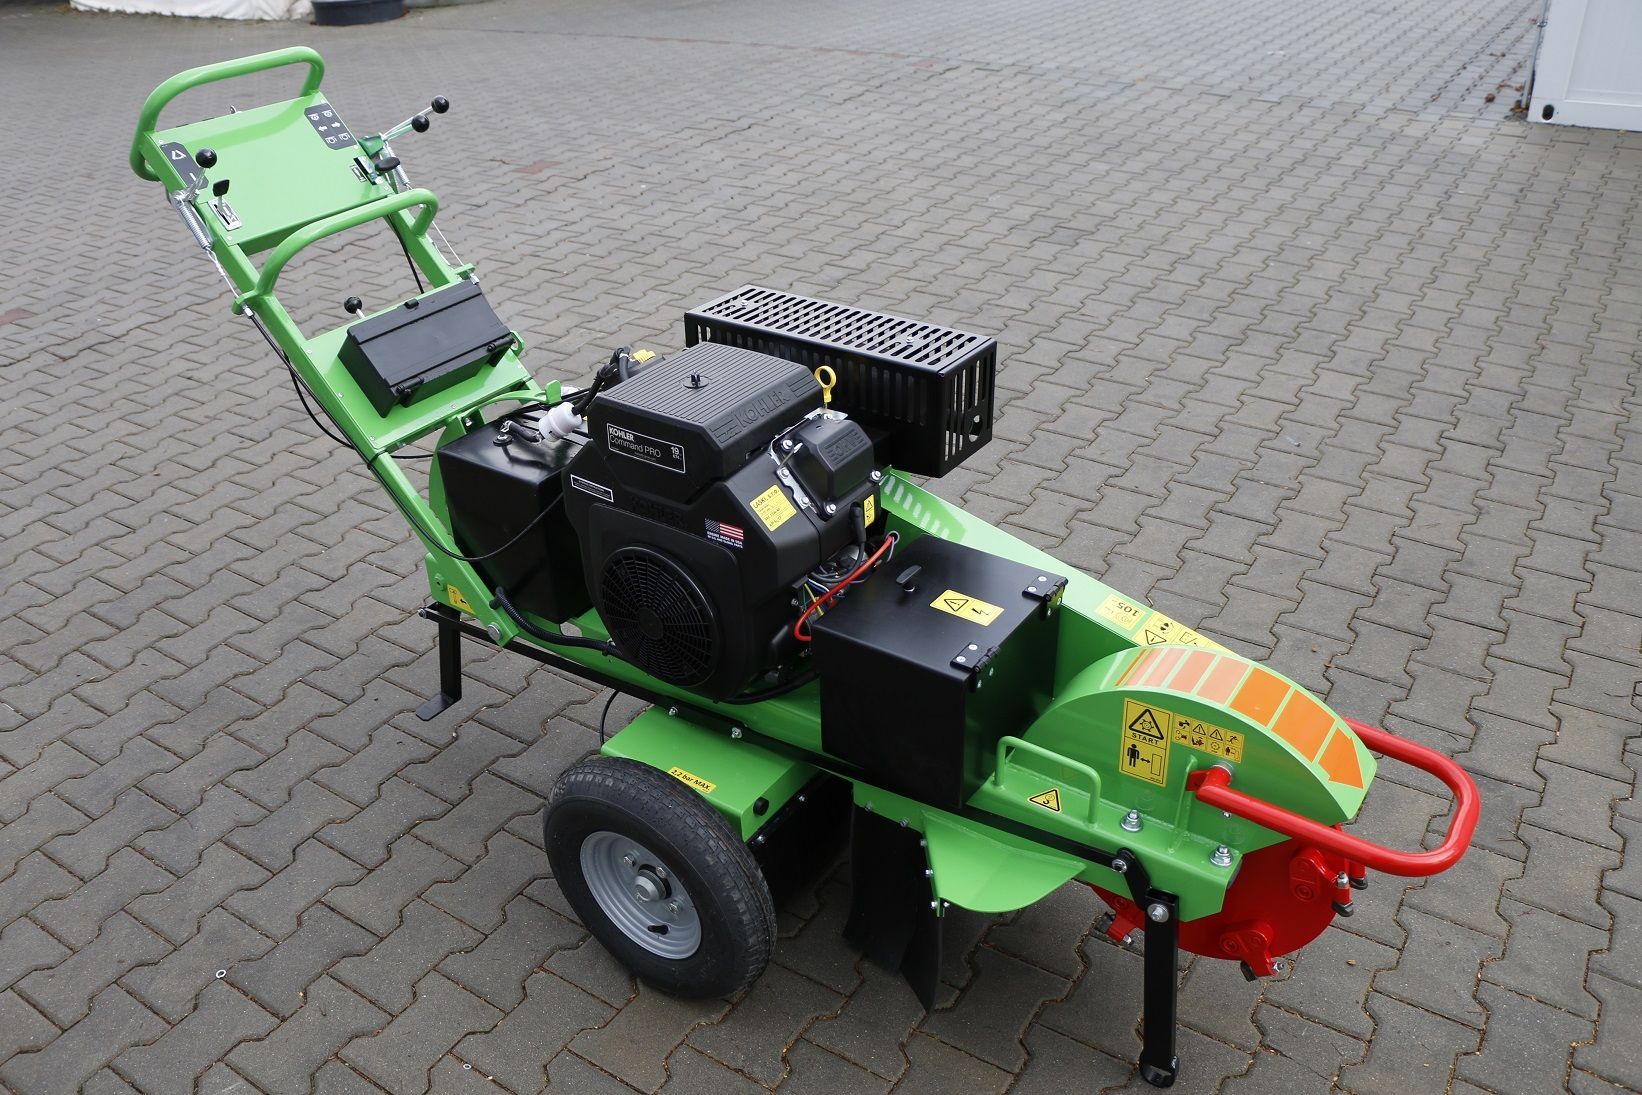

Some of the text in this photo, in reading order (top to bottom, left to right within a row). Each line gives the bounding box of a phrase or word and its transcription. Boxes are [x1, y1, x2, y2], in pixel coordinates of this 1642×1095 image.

[732, 391, 790, 428] KOHLER
[609, 426, 635, 442] KOHLER
[609, 434, 644, 453] Command
[644, 445, 662, 458] PRO
[671, 446, 680, 455] 19
[1116, 602, 1140, 617] 105
[1131, 732, 1160, 745] START
[682, 774, 694, 782] bar
